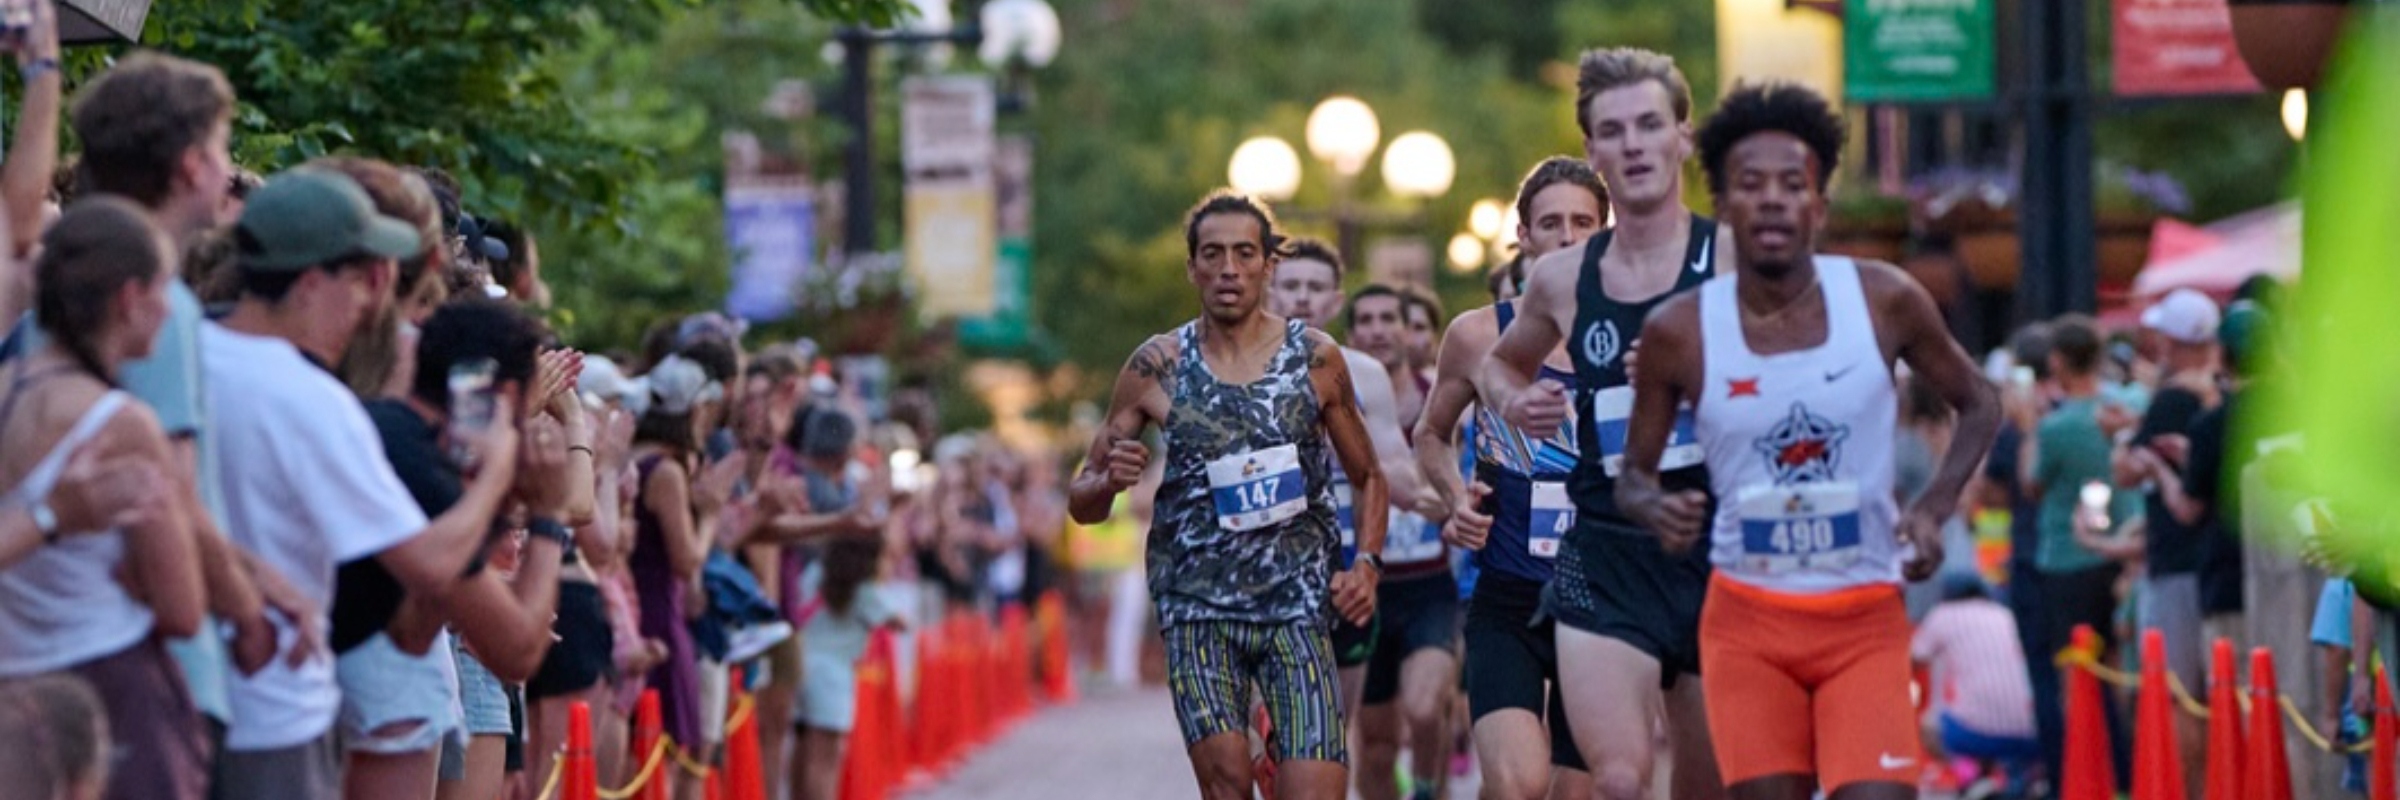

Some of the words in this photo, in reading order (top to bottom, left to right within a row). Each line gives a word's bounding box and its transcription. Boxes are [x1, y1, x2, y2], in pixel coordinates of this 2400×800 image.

[1596, 331, 1611, 354] B
[1236, 477, 1280, 512] 147
[1770, 519, 1834, 552] 490
